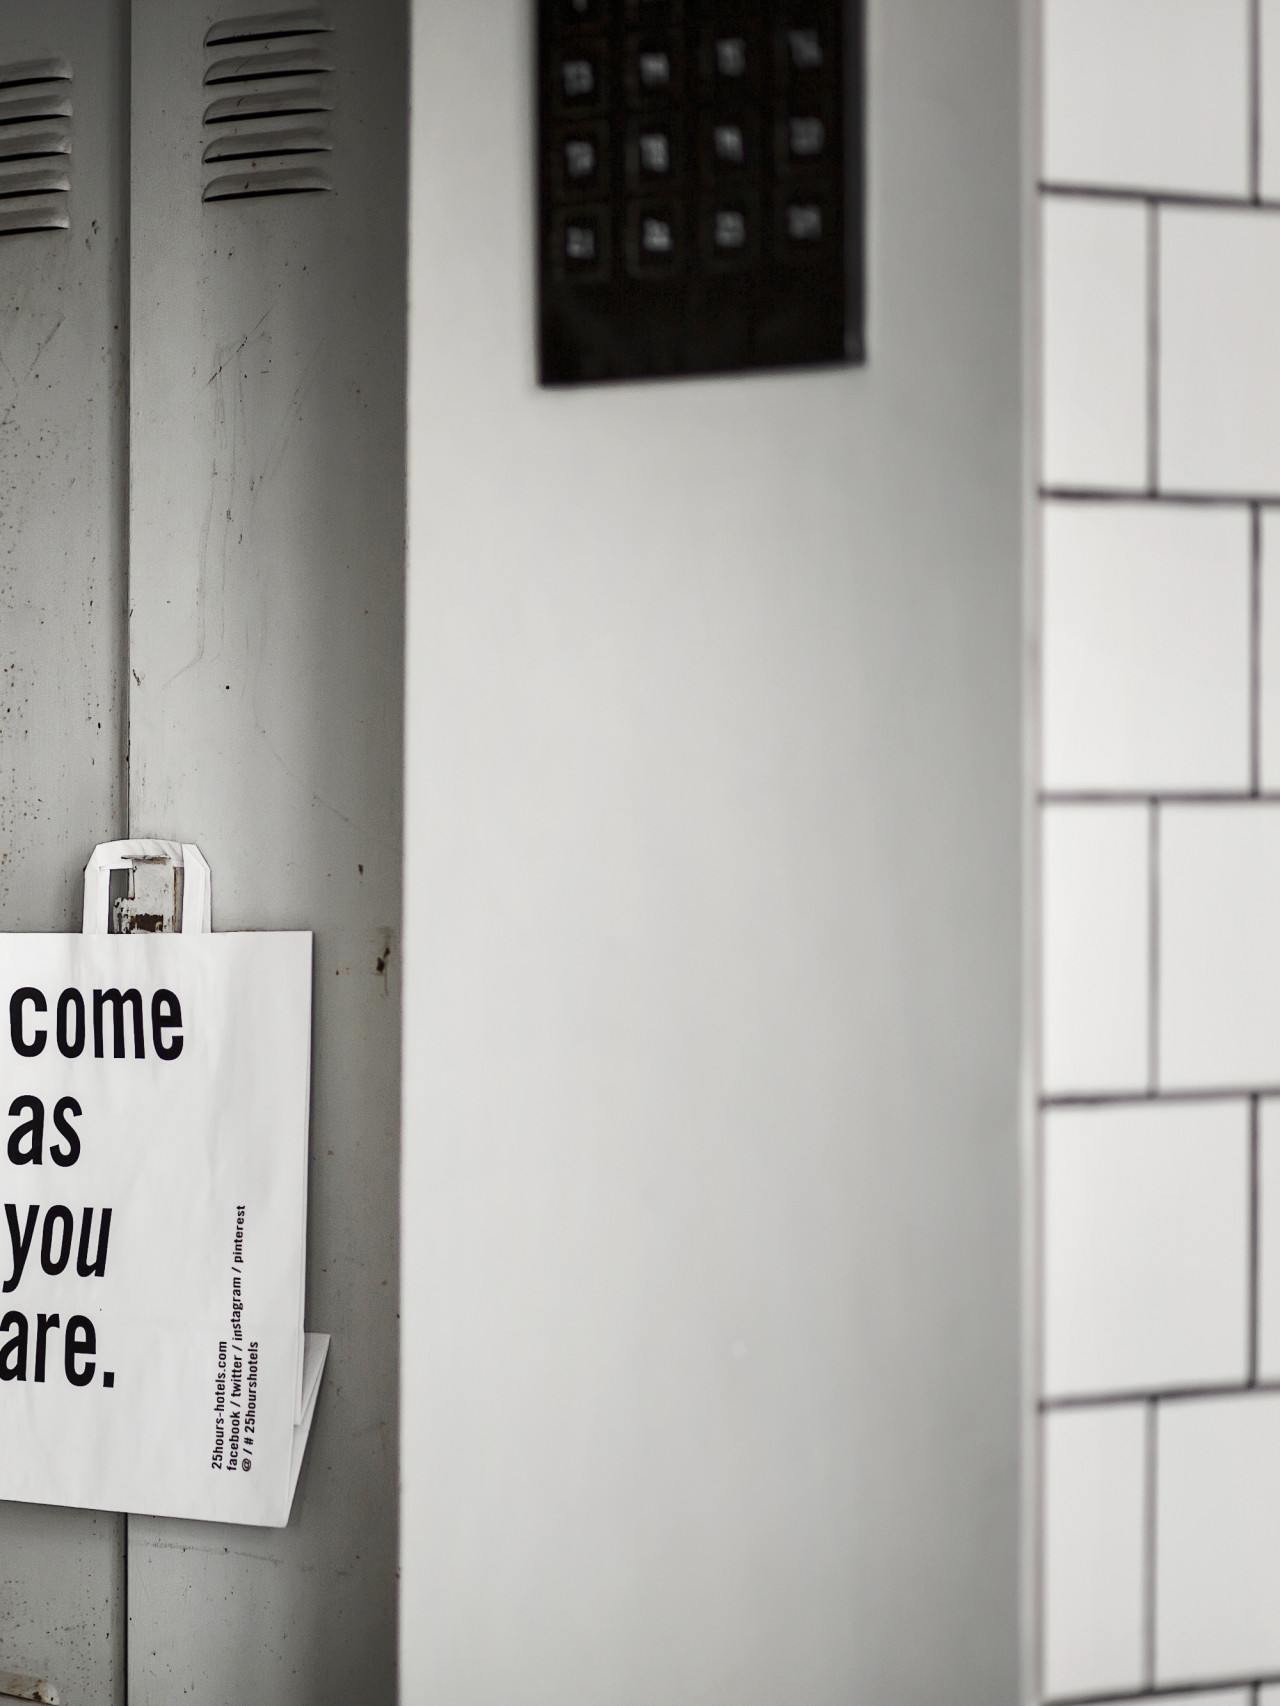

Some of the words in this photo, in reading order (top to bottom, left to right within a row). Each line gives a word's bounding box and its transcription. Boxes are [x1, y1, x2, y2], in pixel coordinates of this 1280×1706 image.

[9, 986, 184, 1061] come
[7, 1094, 83, 1168] as
[1, 1203, 113, 1294] you
[232, 1205, 245, 1263] pinterest
[230, 1276, 243, 1341] instagram
[211, 1341, 227, 1470] 25hours-hotels.com
[230, 1354, 242, 1397] twitter
[244, 1341, 258, 1434] 25hourshotels
[226, 1411, 240, 1471] facebook
[241, 1458, 252, 1472] @
